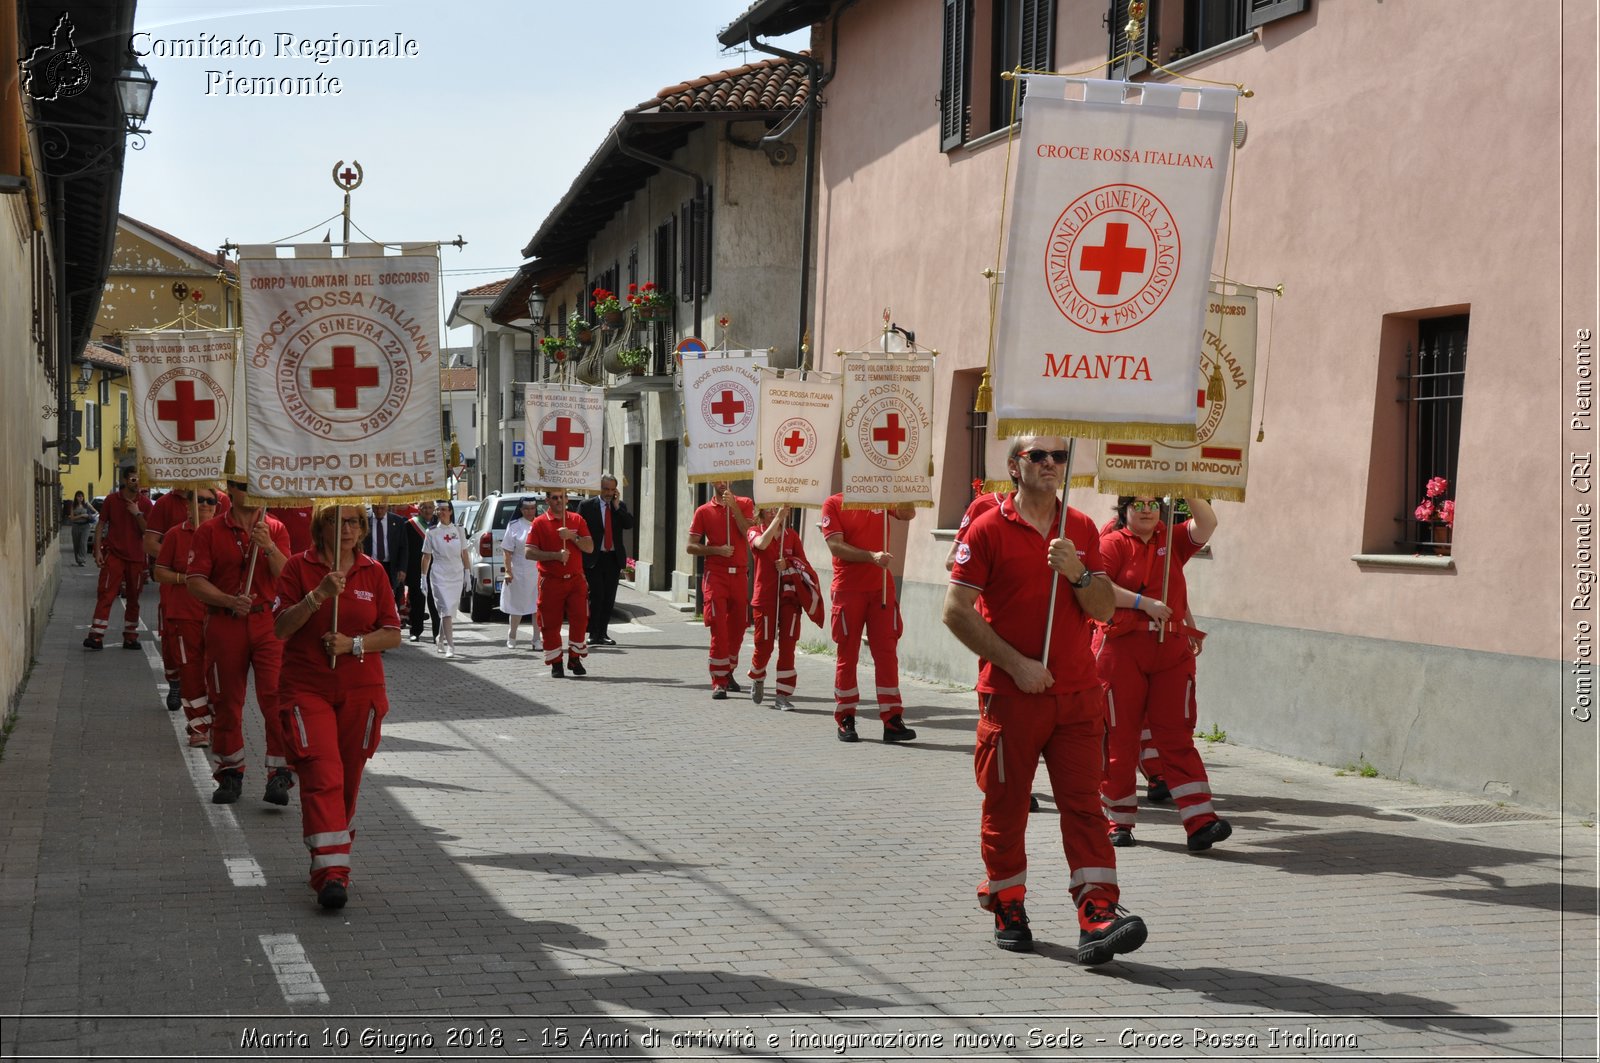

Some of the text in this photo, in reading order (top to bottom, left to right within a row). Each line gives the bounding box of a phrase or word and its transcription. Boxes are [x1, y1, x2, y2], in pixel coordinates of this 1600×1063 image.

[1037, 144, 1215, 170] CROCE ROSSA ITALIANA
[1050, 189, 1174, 325] CONVENZIONE DI GINEVRA 22 AGOSTO 1864
[250, 271, 430, 290] CORPO VOLONTARI DEL SOCCORSO
[1210, 303, 1246, 316] SOCCORSO
[252, 290, 432, 369] CROCE ROSSA ITALIANA
[319, 318, 384, 341] GINEVRA
[298, 330, 315, 346] DI
[188, 344, 201, 353] DEL
[384, 340, 401, 357] 22
[130, 352, 232, 364] CROCE ROSSA ITALIAN
[1202, 329, 1247, 390] ITALIANA
[1042, 353, 1153, 381] MANTA
[147, 368, 185, 400] CONVENZIONE
[189, 369, 198, 377] DI
[387, 359, 408, 409] AGOSTO
[693, 370, 712, 389] CROCE
[712, 366, 734, 375] ROSSA
[281, 348, 332, 435] CONVENZIONE
[769, 389, 834, 400] CROCE ROSSA ITALIANA
[845, 394, 869, 428] CROCE
[901, 387, 929, 429] ITALIANA
[1197, 427, 1211, 440] 186
[514, 443, 524, 456] P
[698, 439, 755, 449] COMITATO LOCA
[187, 455, 222, 464] LOCALE
[256, 449, 436, 471] GRUPPO DI MELLE
[713, 459, 751, 468] DRONERO
[1106, 458, 1170, 472] COMITATO
[1175, 461, 1187, 472] DI
[154, 467, 219, 478] RACCONIG
[851, 475, 892, 483] COMITATO
[894, 475, 919, 483] LOCALE
[258, 471, 434, 491] COMITATO LOCALE
[764, 477, 808, 486] DELEGAZIONE
[846, 485, 879, 493] BORGO
[882, 485, 891, 493] S.
